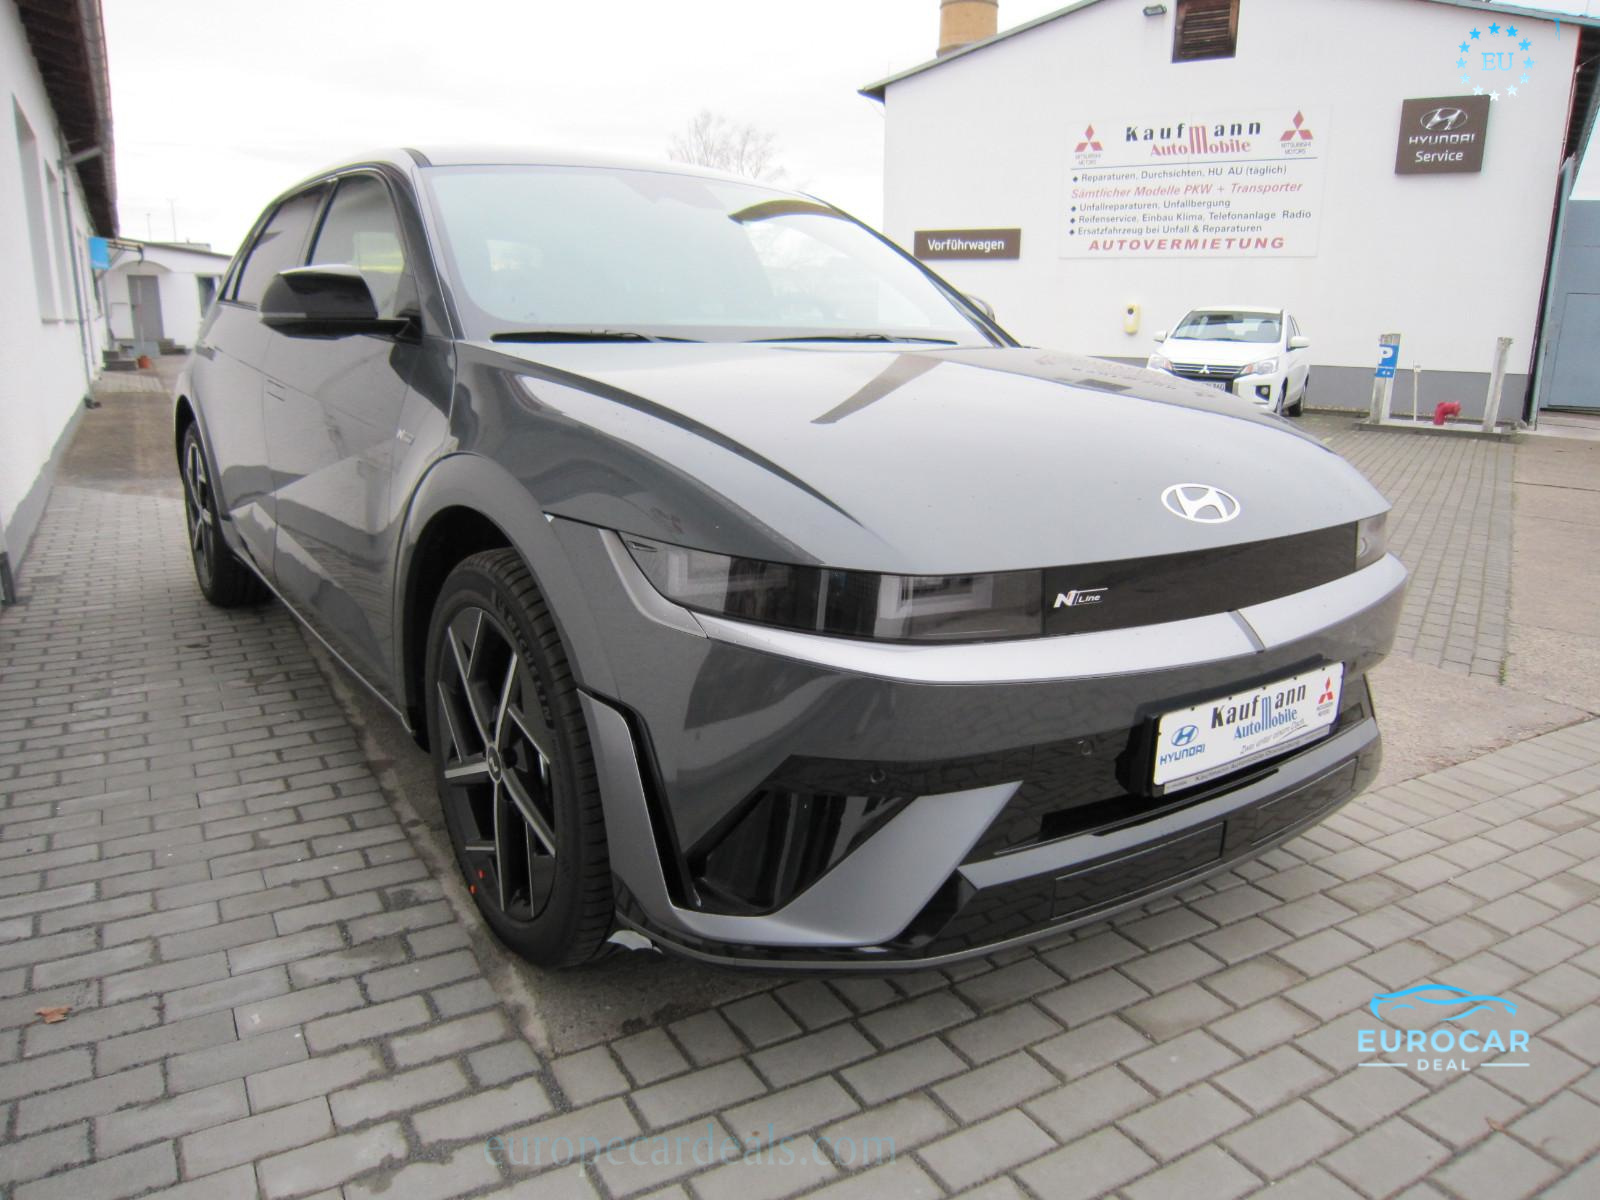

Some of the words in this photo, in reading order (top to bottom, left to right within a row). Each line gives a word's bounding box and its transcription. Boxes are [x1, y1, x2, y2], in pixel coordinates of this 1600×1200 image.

[1408, 133, 1475, 145] HYUNDAI
[1415, 150, 1464, 163] Service
[1081, 172, 1138, 183] Reparaturen,
[1141, 168, 1205, 180] Durchsichten,
[1134, 184, 1181, 197] Modelle
[1183, 183, 1213, 195] PKW
[1217, 185, 1225, 193] +
[1231, 182, 1303, 195] Transporter
[1163, 199, 1231, 210] Unfallbergung
[1142, 212, 1174, 222] Einbau
[1209, 211, 1276, 221] Telefonanlage
[1282, 209, 1312, 219] Radio
[1077, 225, 1143, 236] Ersatzfahrzeug
[1145, 225, 1160, 234] bei
[1162, 224, 1190, 234] Unfall
[1192, 225, 1199, 233] &
[1202, 224, 1262, 235] Reparaturen
[927, 239, 1005, 253] Vorführwagen
[1088, 236, 1285, 251] AUTOVERMIETUNG
[1379, 347, 1393, 364] P
[1053, 590, 1077, 608] N
[1078, 595, 1101, 603] Line
[1159, 743, 1206, 766] HYUNDAI
